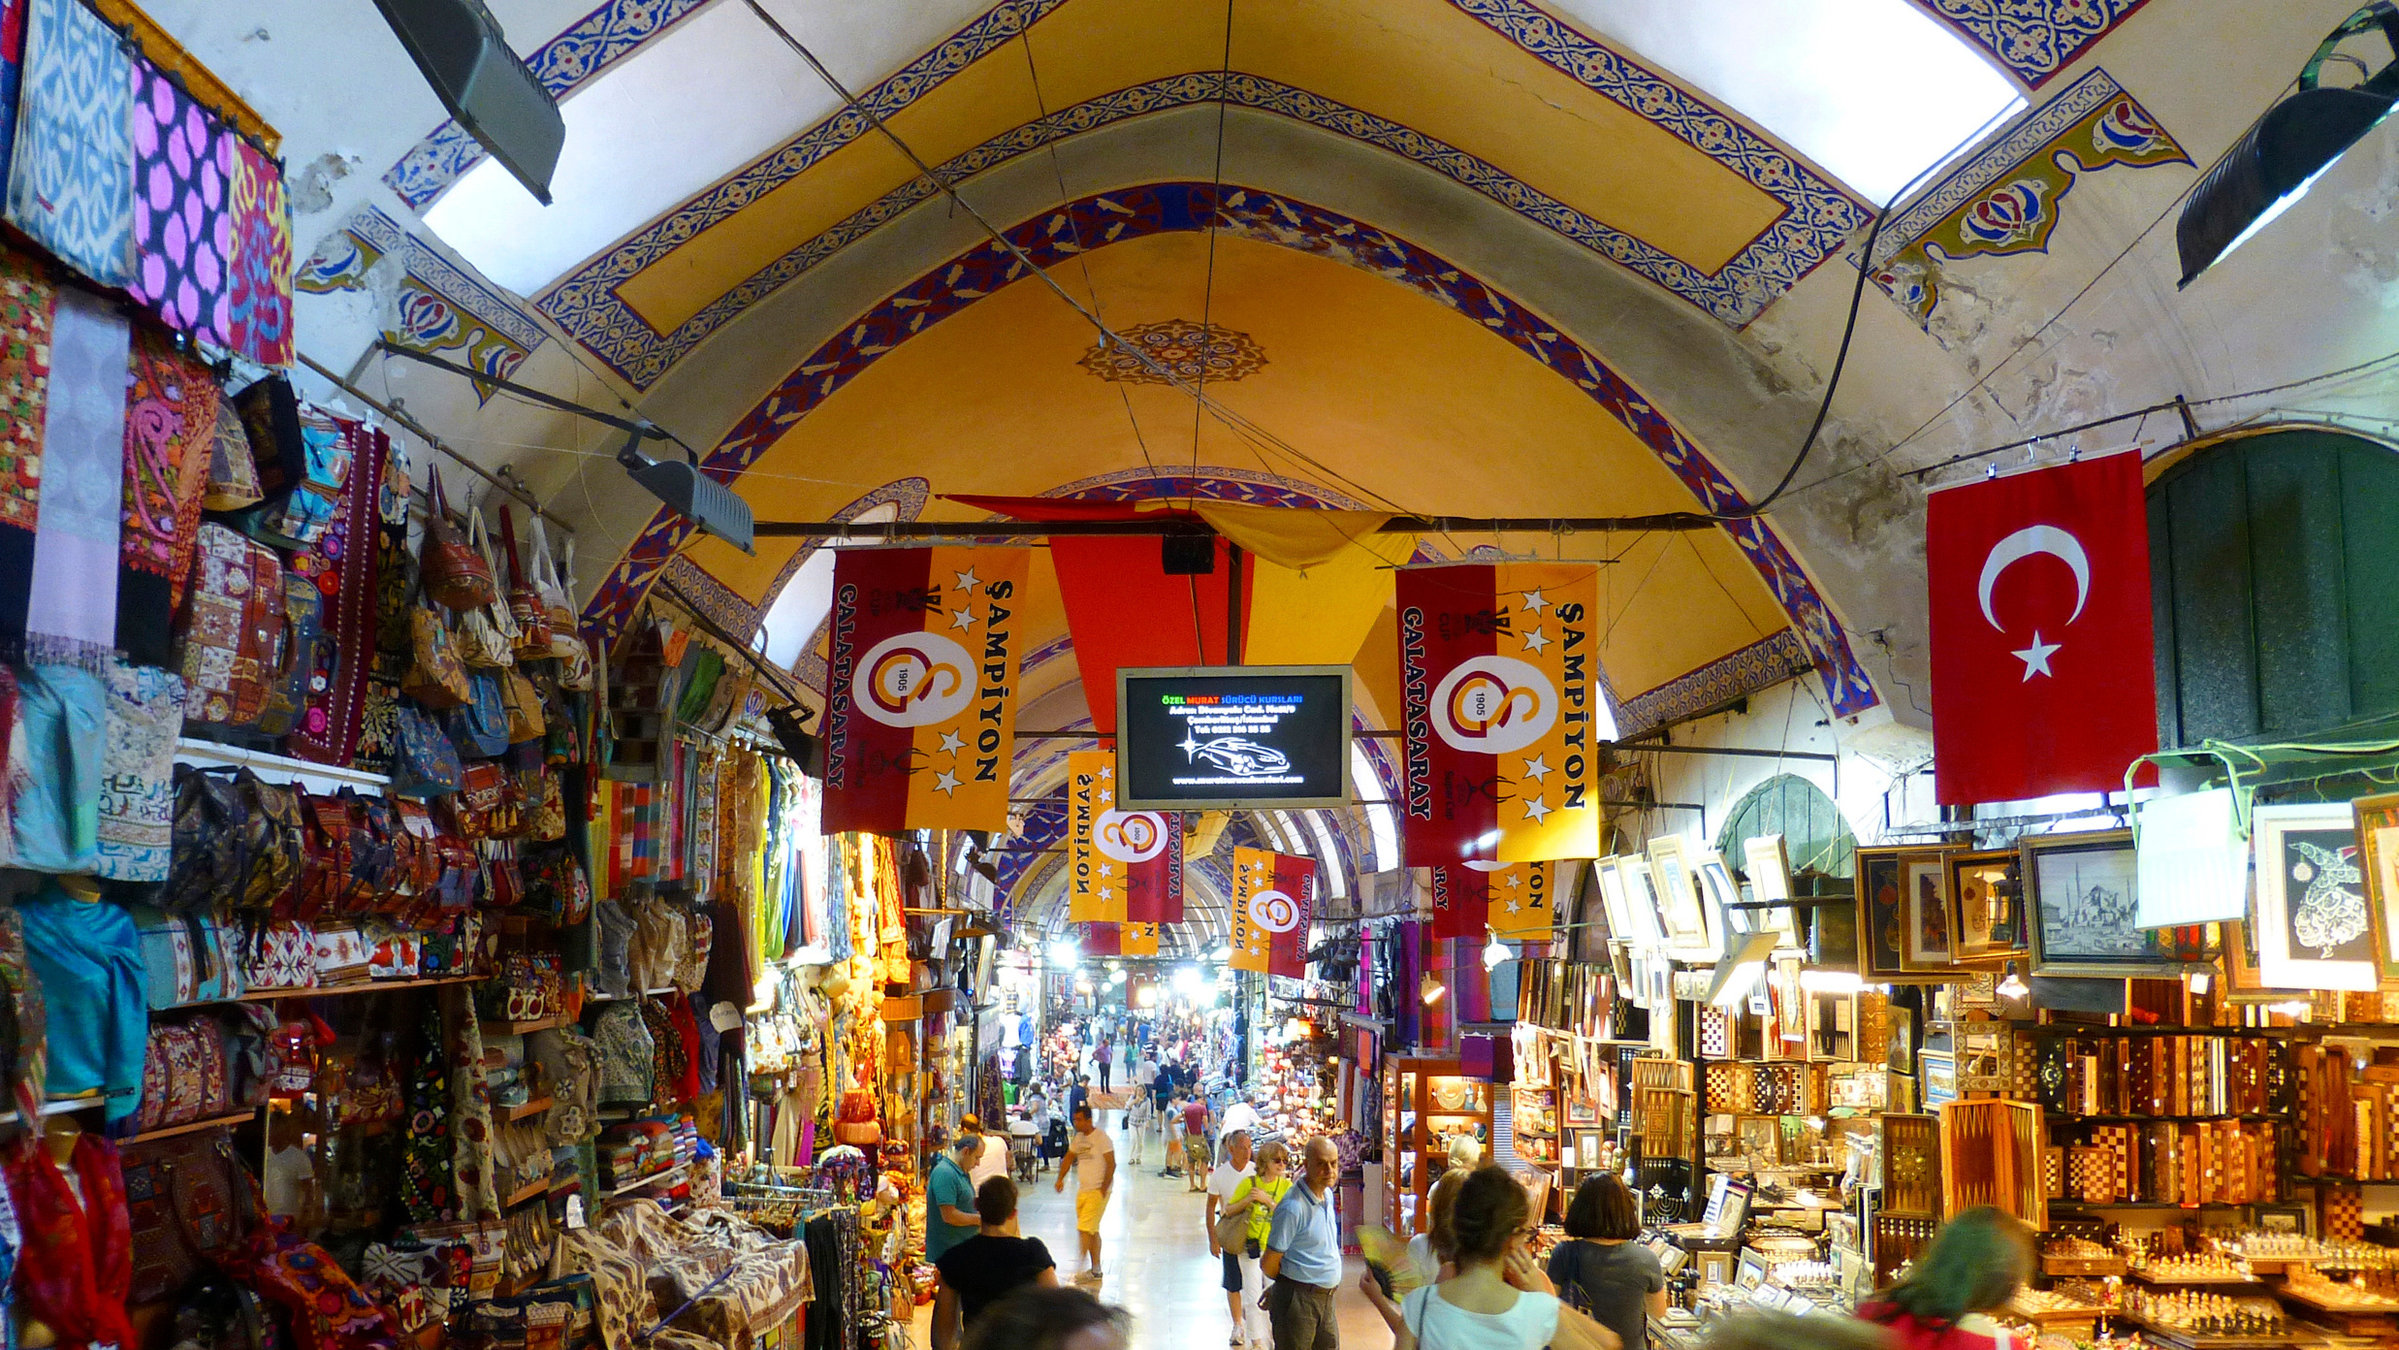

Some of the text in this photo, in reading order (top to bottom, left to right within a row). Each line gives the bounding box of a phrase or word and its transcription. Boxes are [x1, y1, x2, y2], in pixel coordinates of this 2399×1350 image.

[827, 583, 858, 789] GALATASARAY
[897, 667, 908, 692] 1905
[975, 579, 1014, 782] ŞAMPİYON
[1162, 695, 1303, 704] ÖZEL MURAT SÜRÜCÜ KURSLARI
[1402, 606, 1431, 821] GALATASARAY
[1475, 691, 1486, 716] 1905
[1555, 602, 1590, 810] ŞAMPİYON
